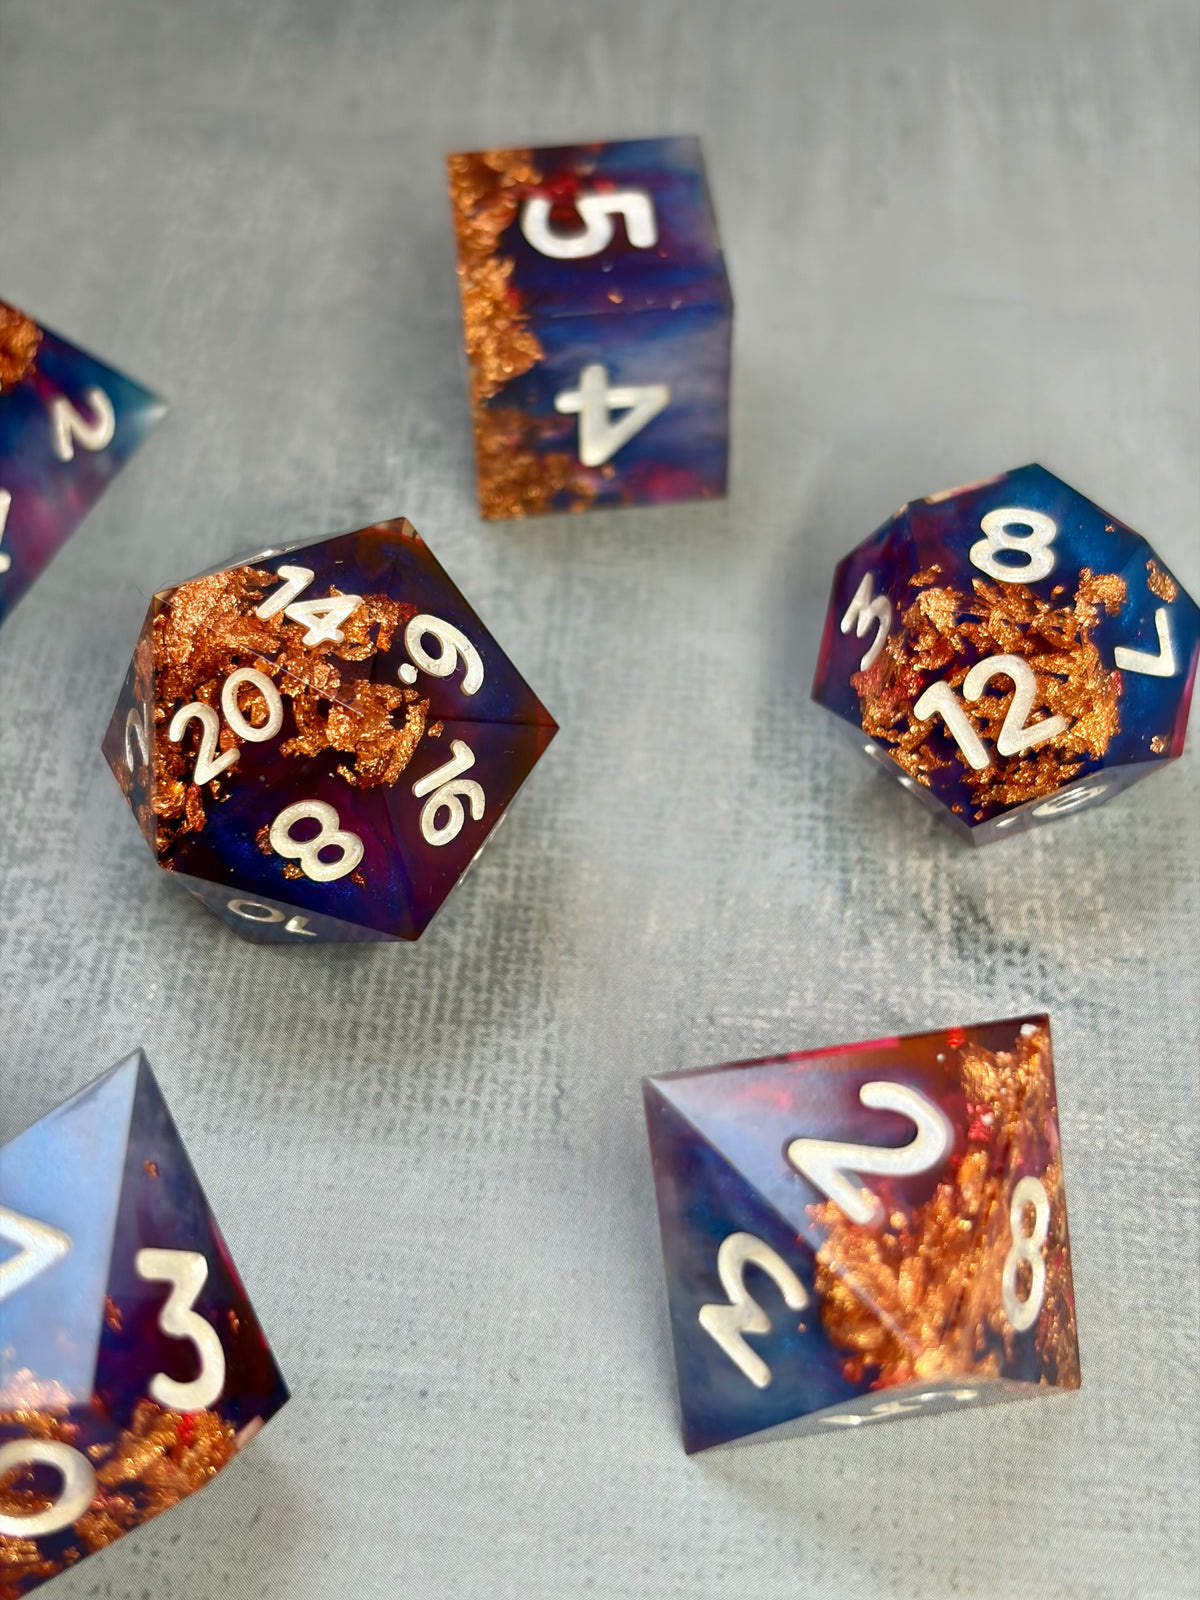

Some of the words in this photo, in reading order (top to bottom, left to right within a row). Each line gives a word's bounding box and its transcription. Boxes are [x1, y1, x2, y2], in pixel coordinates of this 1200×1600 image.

[520, 190, 660, 261] 5
[54, 387, 118, 462] 2
[552, 361, 674, 470] 4
[968, 507, 1058, 584] 8
[255, 564, 364, 649] 14
[840, 571, 893, 672] 3
[1113, 606, 1176, 678] 7
[168, 666, 283, 787] 20
[913, 653, 1068, 771] 12
[268, 799, 365, 883] 8
[411, 739, 486, 848] 16
[786, 1080, 953, 1224] 2
[1001, 1175, 1052, 1333] 8
[134, 1247, 226, 1412] 3
[698, 1230, 810, 1389] 3
